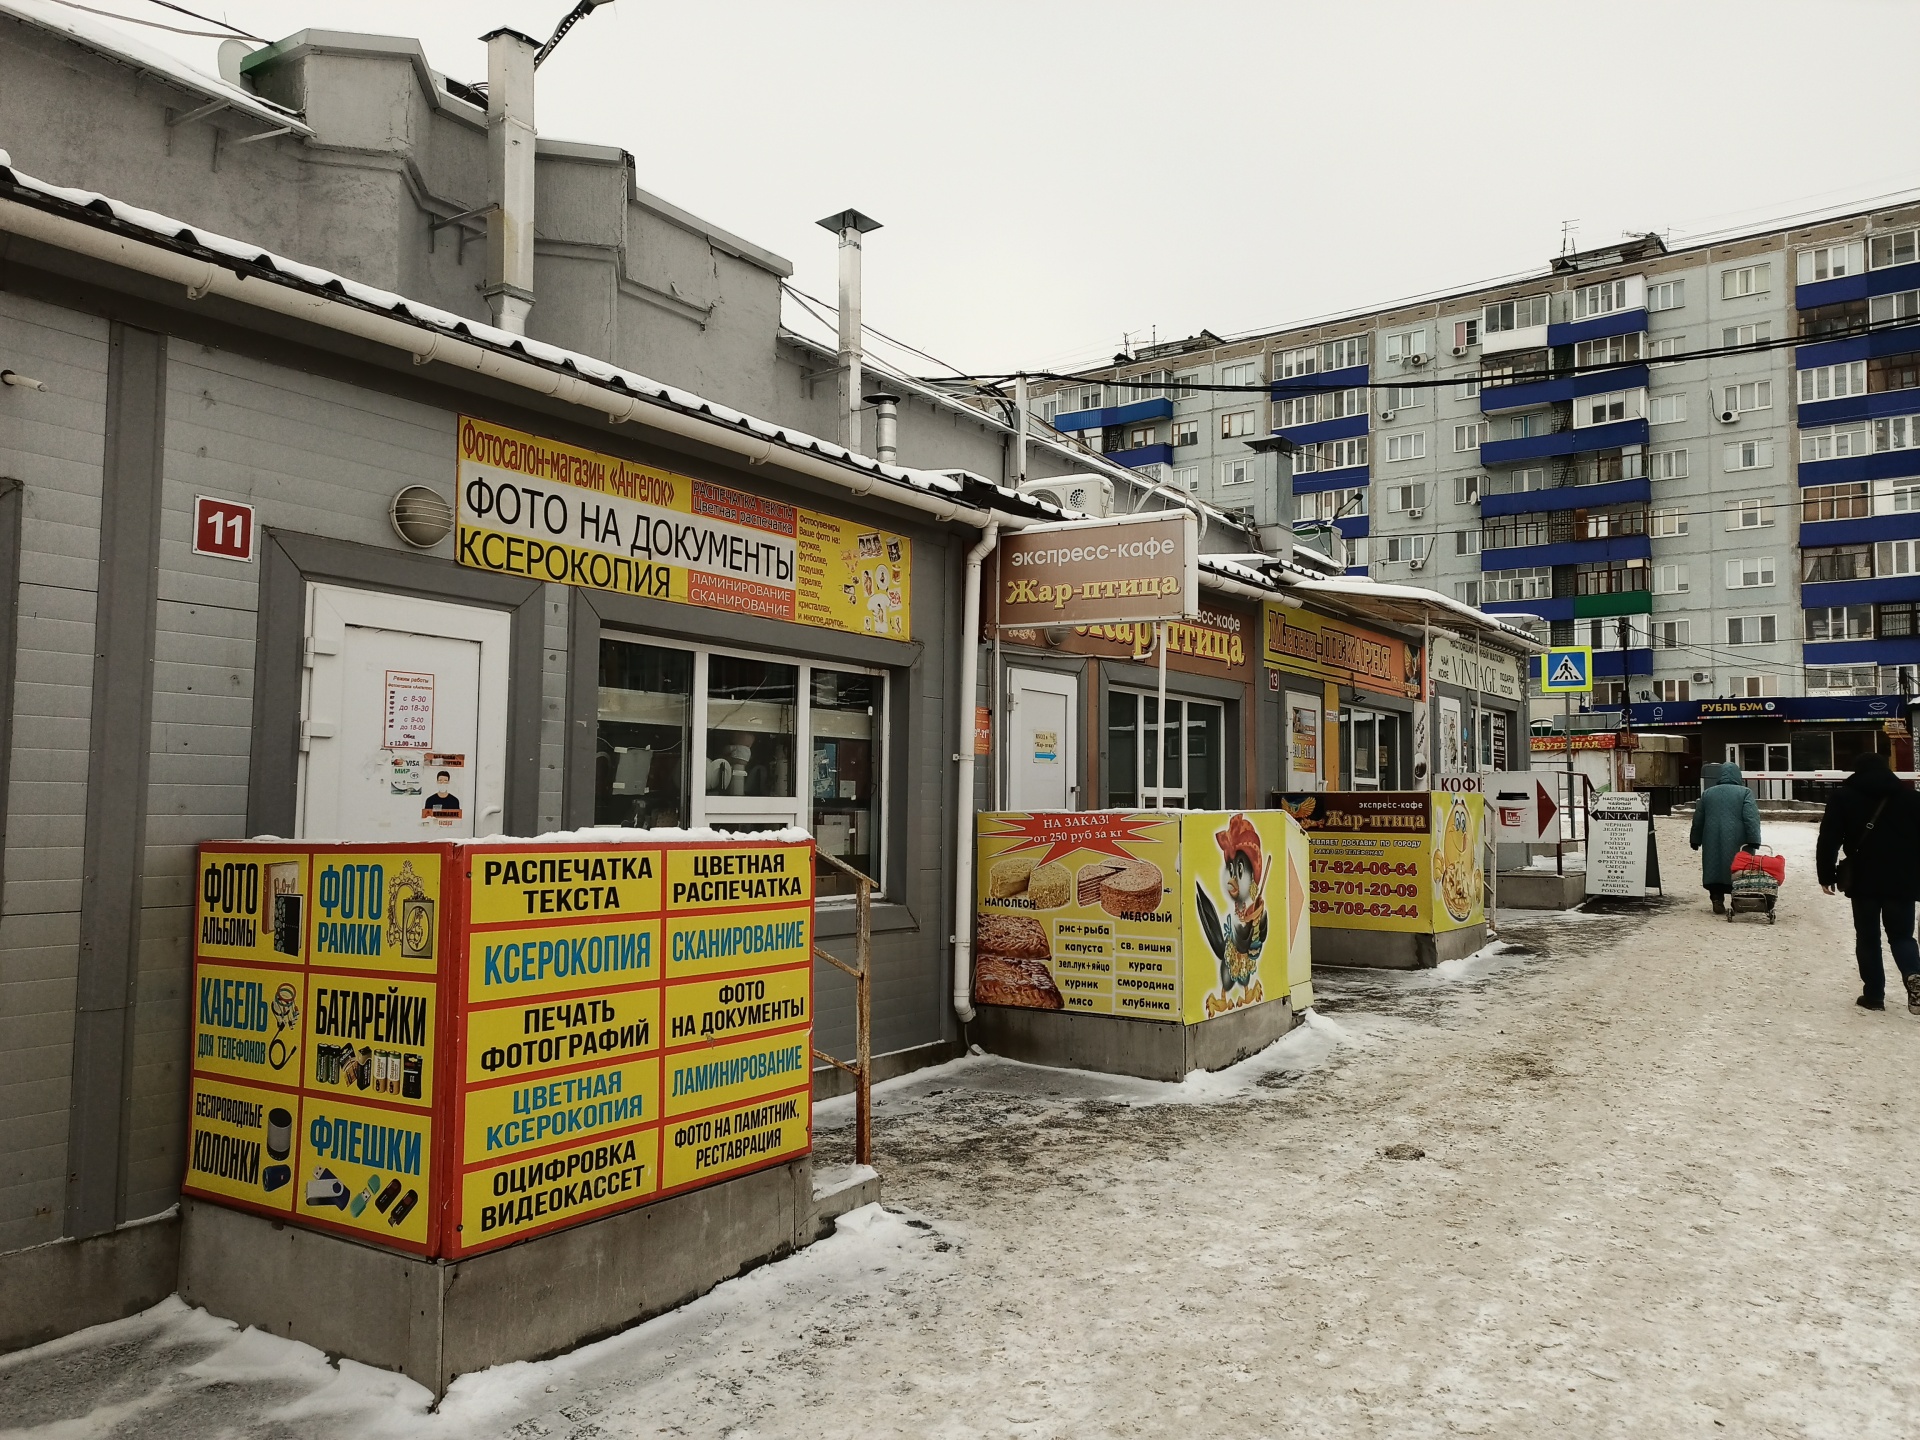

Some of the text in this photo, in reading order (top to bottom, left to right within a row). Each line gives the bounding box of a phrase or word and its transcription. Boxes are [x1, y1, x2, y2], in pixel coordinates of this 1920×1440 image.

[462, 420, 675, 506] Фотосалон-магазин «Ангелок»
[692, 482, 794, 521] РАСПЕЧАТКА ТЕКСТА
[693, 496, 793, 534] Цветная распечатка
[207, 511, 243, 548] 11
[466, 477, 795, 584] ФОТО НА ДОКУМЕНТЫ
[799, 514, 841, 533] Фотосувениры
[799, 527, 841, 544] Ваше фото на:
[798, 541, 821, 553] кружке,
[798, 551, 828, 567] футболке,
[1011, 537, 1175, 567] экспресс-кафе
[459, 527, 671, 598] КСЕРОКОПИЯ
[798, 565, 825, 577] подушке,
[691, 573, 791, 602] ЛАМИНИРОВАНИЕ
[798, 577, 823, 589] тарелке,
[1006, 576, 1181, 609] Жар-птица
[691, 588, 790, 617] СКАНИРОВАНИЕ
[1269, 610, 1392, 681] Мини-ПЕКАРНЯ
[1438, 668, 1449, 680] КОФЕ
[1441, 655, 1449, 666] ЧАЙ
[1271, 672, 1278, 687] 13
[1701, 702, 1763, 712] РУБЛЬ БУМ
[1326, 810, 1426, 831] Жар-птица
[1359, 801, 1423, 811] экспресс-кафе
[1033, 829, 1123, 844] от 250 руб за кг
[1044, 815, 1109, 829] НА ЗАКАЗ!
[1393, 840, 1421, 848] ГОРОДУ
[484, 857, 653, 886] РАСПЕЧАТКА
[693, 854, 785, 878] ЦВЕТНАЯ
[1309, 860, 1417, 876] 17-824-06-64
[204, 863, 258, 914] ФОТО
[319, 864, 383, 920] ФОТО
[523, 887, 620, 914] ТЕКСТА
[673, 876, 802, 904] РАСПЕЧАТКА
[984, 897, 1036, 910] НАПОЛЕОН
[1120, 910, 1172, 923] МЕДОВЫЙ
[202, 917, 256, 948] АЛЬБОМЫ
[318, 922, 382, 956] РАМКИ
[672, 920, 804, 963] СКАНИРОВАНИЕ
[1058, 924, 1110, 937] рис+рыба
[484, 931, 651, 986] КСЕРОКОПИЯ
[1064, 943, 1103, 954] капуста
[1120, 942, 1171, 954] св. вишня
[1058, 959, 1110, 973] зел.лук+яйцо
[1128, 961, 1162, 973] курага
[719, 980, 765, 1005] ФОТО
[1064, 979, 1099, 990] курник
[1117, 979, 1175, 991] смородина
[200, 976, 268, 1032] КАБЕЛЬ
[315, 986, 426, 1046] БАТАРЕЙКИ
[1069, 998, 1093, 1007] мясо
[1122, 997, 1170, 1010] клубника
[523, 1000, 615, 1035] ПЕЧАТЬ
[671, 997, 804, 1038] НА ДОКУМЕНТЫ
[197, 1033, 266, 1065] ДЛЯ ТЕЛЕФОНОВ
[481, 1018, 650, 1072] ФОТОГРАФИЙ
[672, 1045, 803, 1098] ЛАМИНИРОВАНИЕ
[512, 1070, 622, 1115] ЦВЕТНАЯ
[196, 1092, 262, 1129] БЕСПРОВОДНЫЕ
[486, 1094, 643, 1151] КСЕРОКОПИЯ
[674, 1098, 801, 1150] ФОТО НА ПАМЯТНИК,
[193, 1129, 260, 1185] КОЛОНКИ
[310, 1115, 421, 1176] ФЛЕШКИ
[695, 1127, 782, 1170] РЕСТАВРАЦИЯ
[492, 1139, 637, 1197] ОЦИФРОВКА
[481, 1165, 645, 1232] ВИДЕОКАССЕТ
